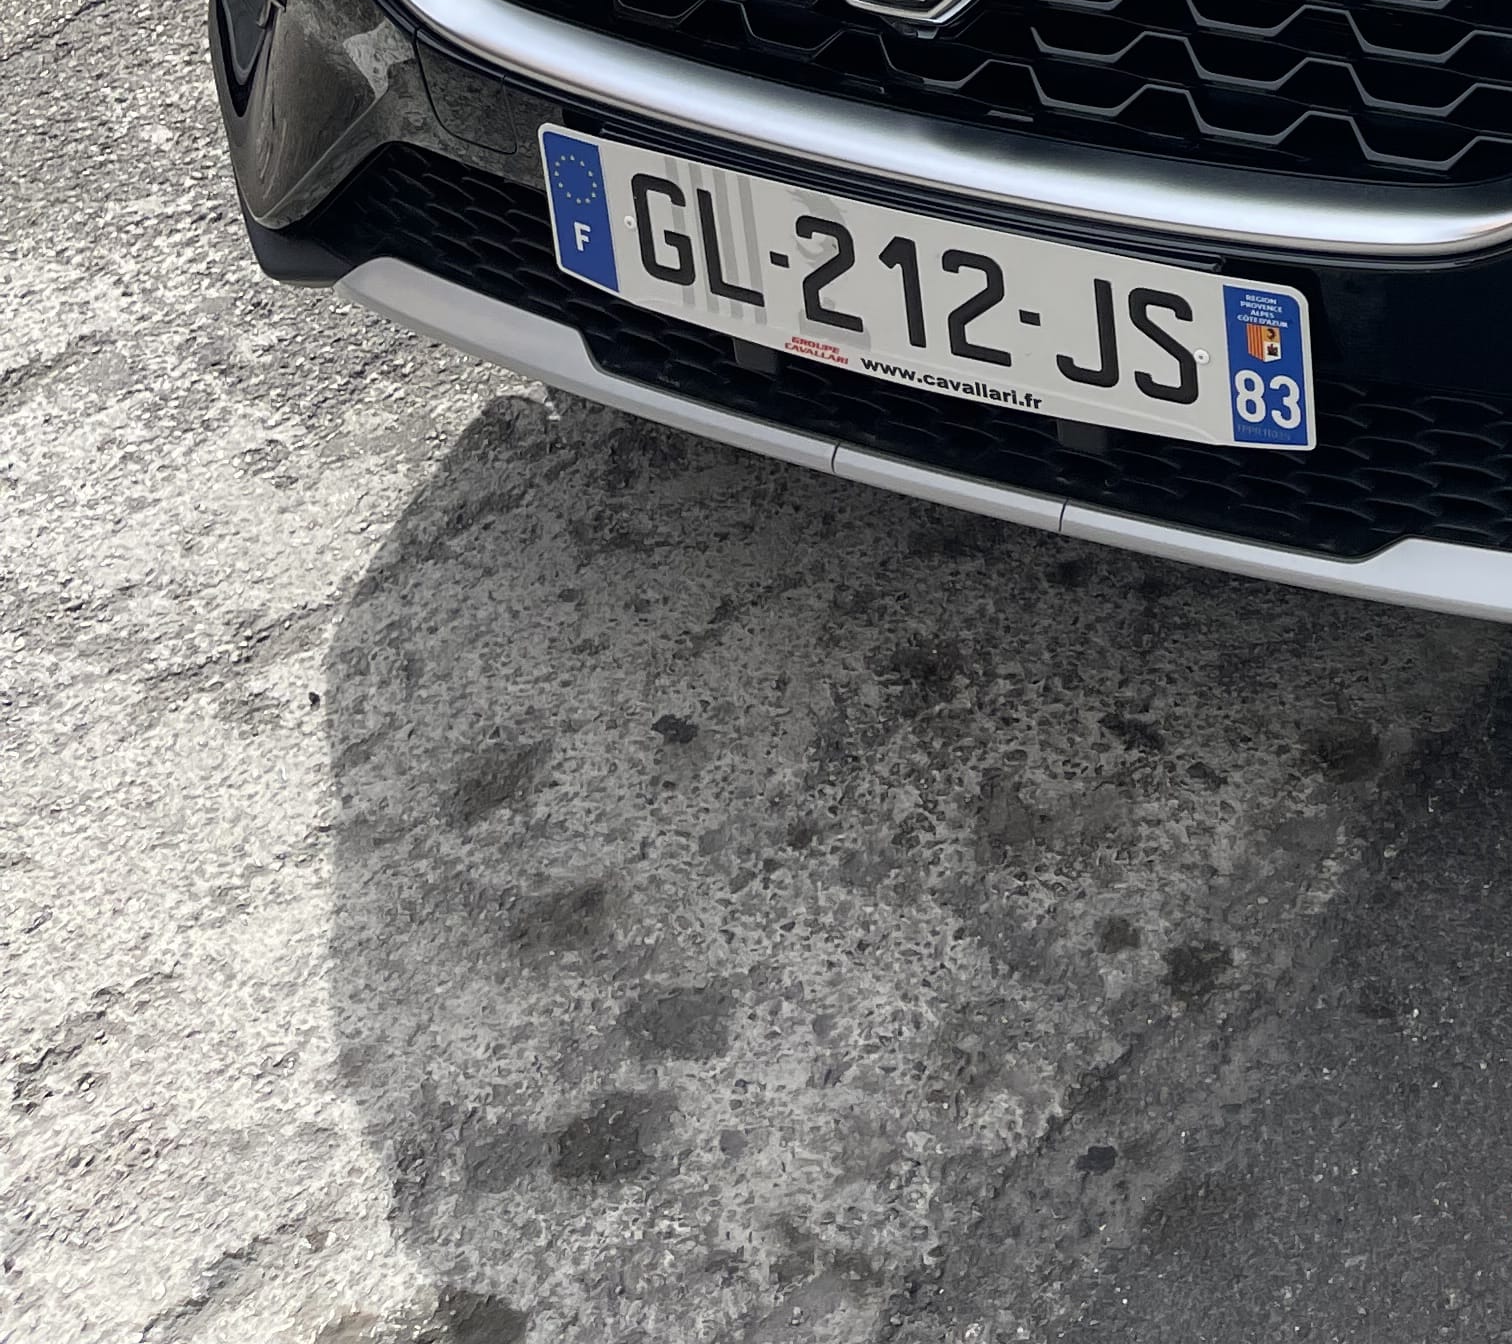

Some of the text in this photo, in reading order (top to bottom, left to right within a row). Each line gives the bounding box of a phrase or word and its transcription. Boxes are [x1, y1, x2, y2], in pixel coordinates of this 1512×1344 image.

[573, 221, 593, 254] F
[630, 172, 1198, 406] GL-212-JS
[1239, 300, 1283, 313] PROVENCE
[1250, 309, 1275, 319] ALPES
[784, 341, 849, 366] CAVALLARI
[791, 335, 840, 355] GROUPE
[860, 357, 1043, 410] www.cavallari.fr
[1235, 370, 1301, 429] 83
